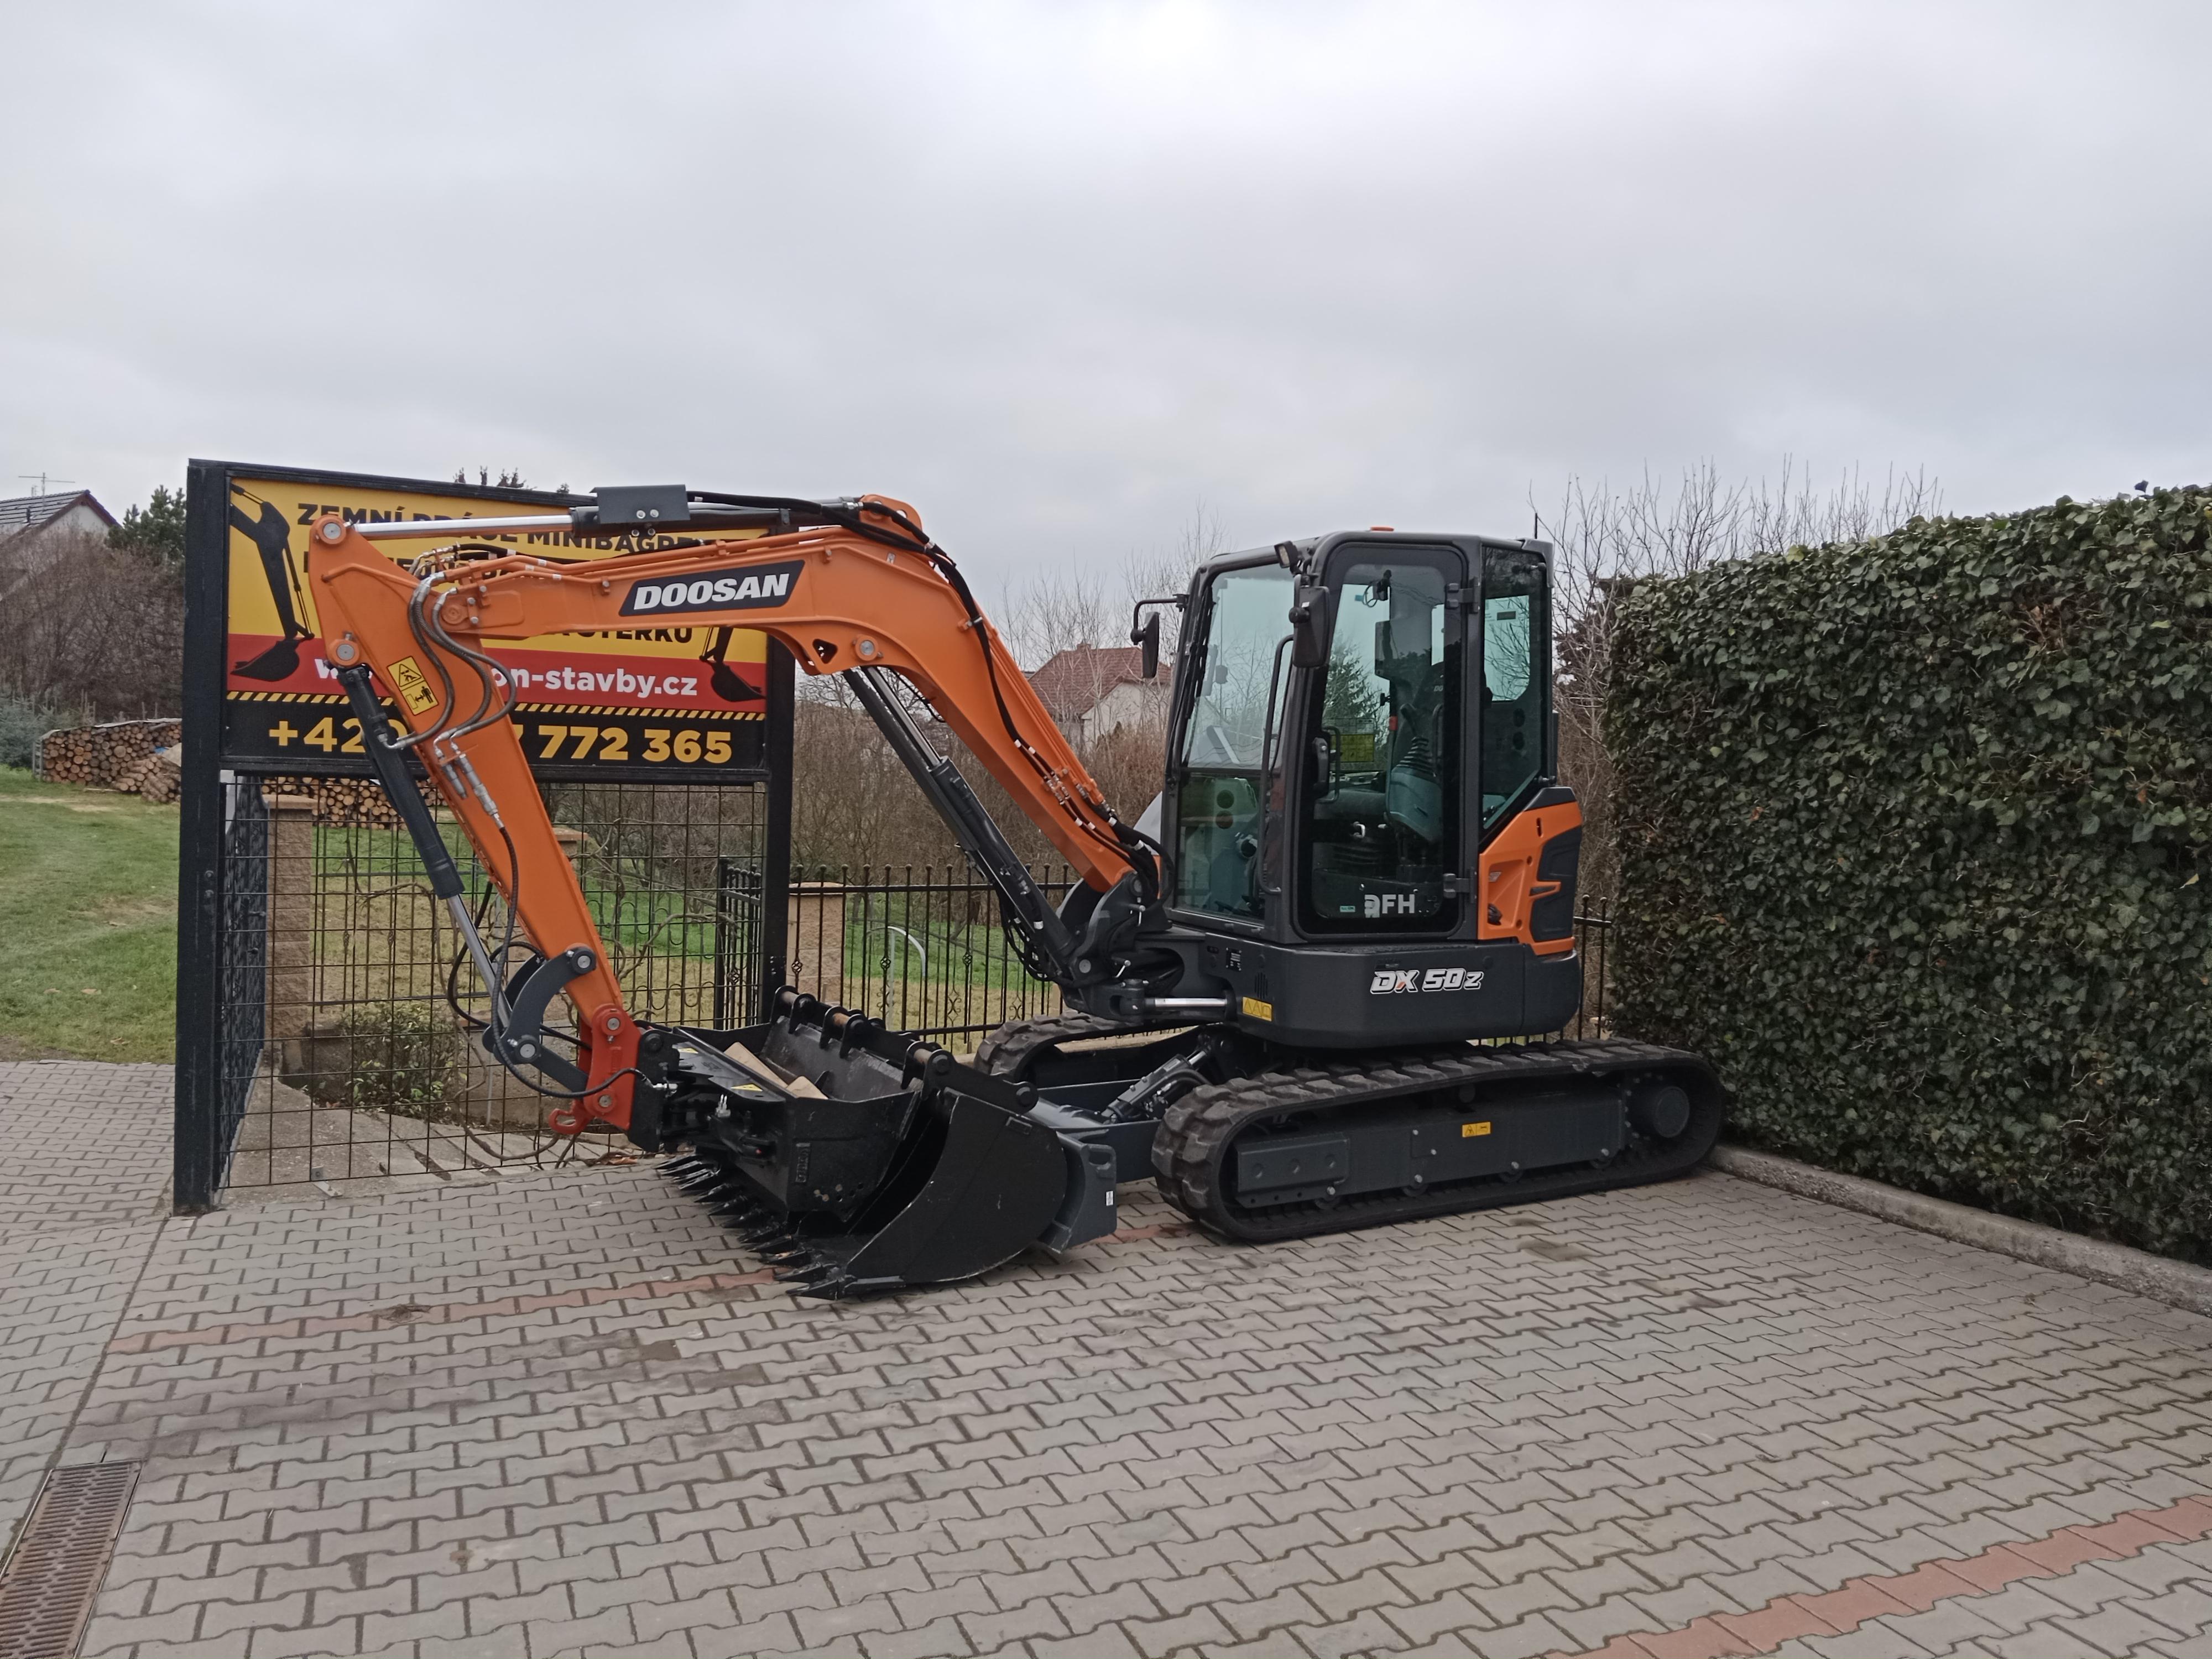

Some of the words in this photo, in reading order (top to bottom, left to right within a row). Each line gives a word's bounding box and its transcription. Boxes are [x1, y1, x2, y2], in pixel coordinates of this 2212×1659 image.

[634, 573, 790, 610] DOOSAN
[539, 724, 629, 760] 772
[641, 729, 732, 763] 365
[1370, 969, 1420, 994] DX
